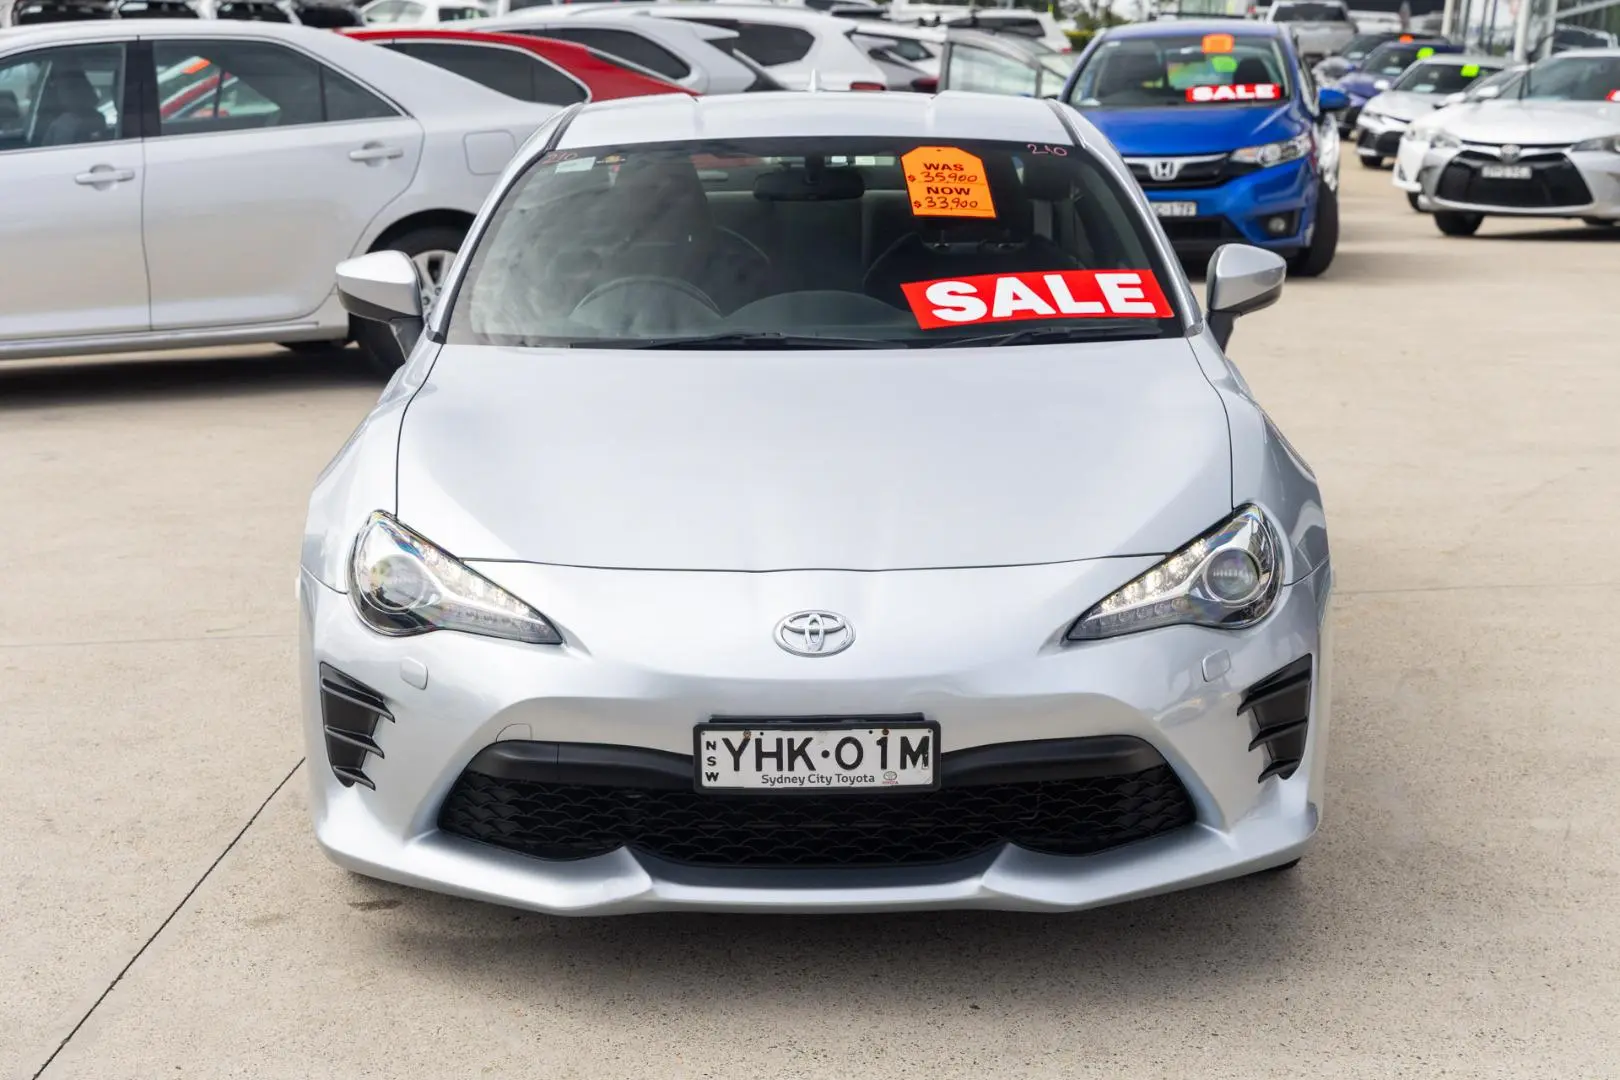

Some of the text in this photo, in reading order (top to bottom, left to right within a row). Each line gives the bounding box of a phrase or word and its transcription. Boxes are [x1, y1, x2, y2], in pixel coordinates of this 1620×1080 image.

[1192, 83, 1275, 102] SALE
[924, 163, 964, 171] WAS
[926, 187, 971, 196] NOW
[925, 273, 1156, 322] SALE
[761, 774, 806, 786] Sydney
[807, 773, 833, 786] City
[834, 773, 875, 785] Toyota
